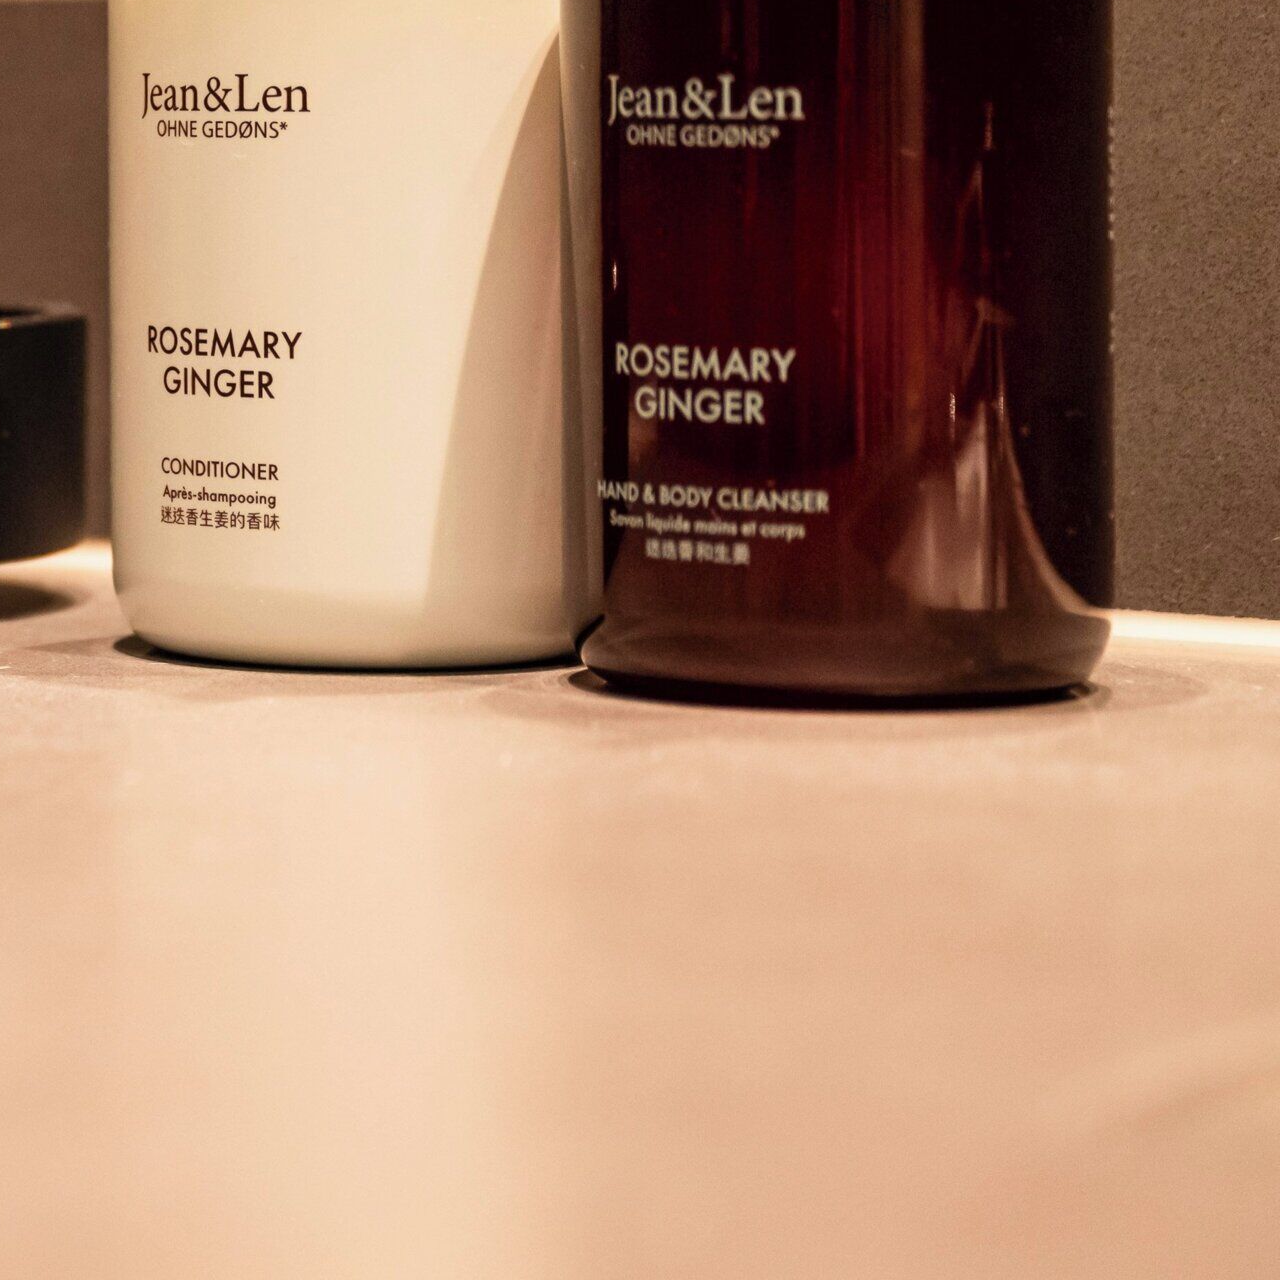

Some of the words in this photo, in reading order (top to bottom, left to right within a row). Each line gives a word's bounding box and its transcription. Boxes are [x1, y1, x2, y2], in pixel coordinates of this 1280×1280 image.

[141, 73, 311, 119] Jean&Len
[607, 73, 806, 127] Jean&Len
[157, 120, 198, 138] OHNE
[626, 124, 677, 147] OHNE
[147, 325, 303, 359] ROSEMARY
[614, 341, 797, 383] ROSEMARY
[163, 366, 276, 399] GINGER
[634, 385, 766, 425] GINGER
[160, 456, 280, 481] CONDITIONER
[162, 484, 277, 510] Après-shampooing
[597, 480, 639, 503] HAND
[643, 483, 655, 503] &
[658, 484, 714, 509] BODY
[716, 487, 831, 513] CLEANSER
[160, 505, 280, 531] 迷迭香生姜的香味
[646, 511, 690, 534] liquide
[741, 522, 757, 537] et
[759, 523, 806, 542] corps
